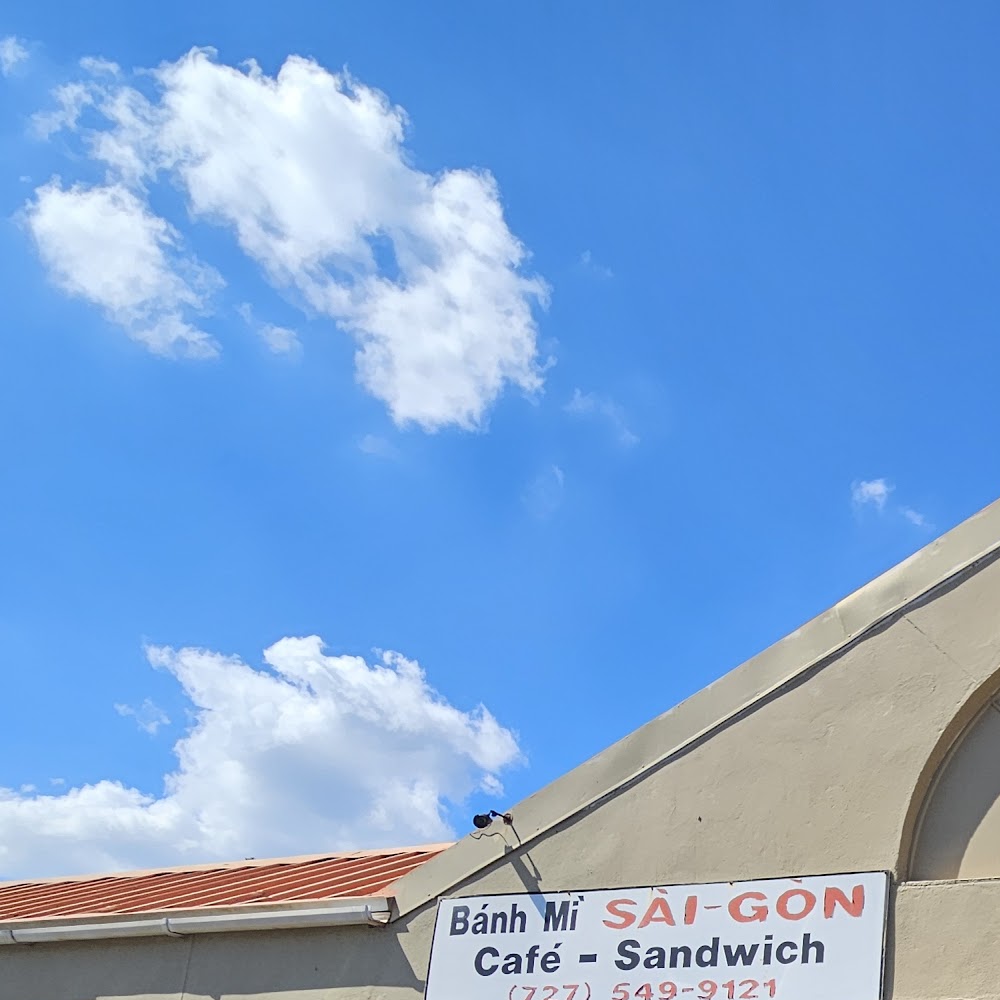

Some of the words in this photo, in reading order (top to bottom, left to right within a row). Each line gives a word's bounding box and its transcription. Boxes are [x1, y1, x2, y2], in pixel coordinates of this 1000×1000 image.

[450, 903, 527, 936] Bánh
[602, 878, 866, 930] SÀI-GÒN
[474, 942, 563, 977] Café
[578, 953, 598, 963] -
[614, 932, 825, 971] Sandwich
